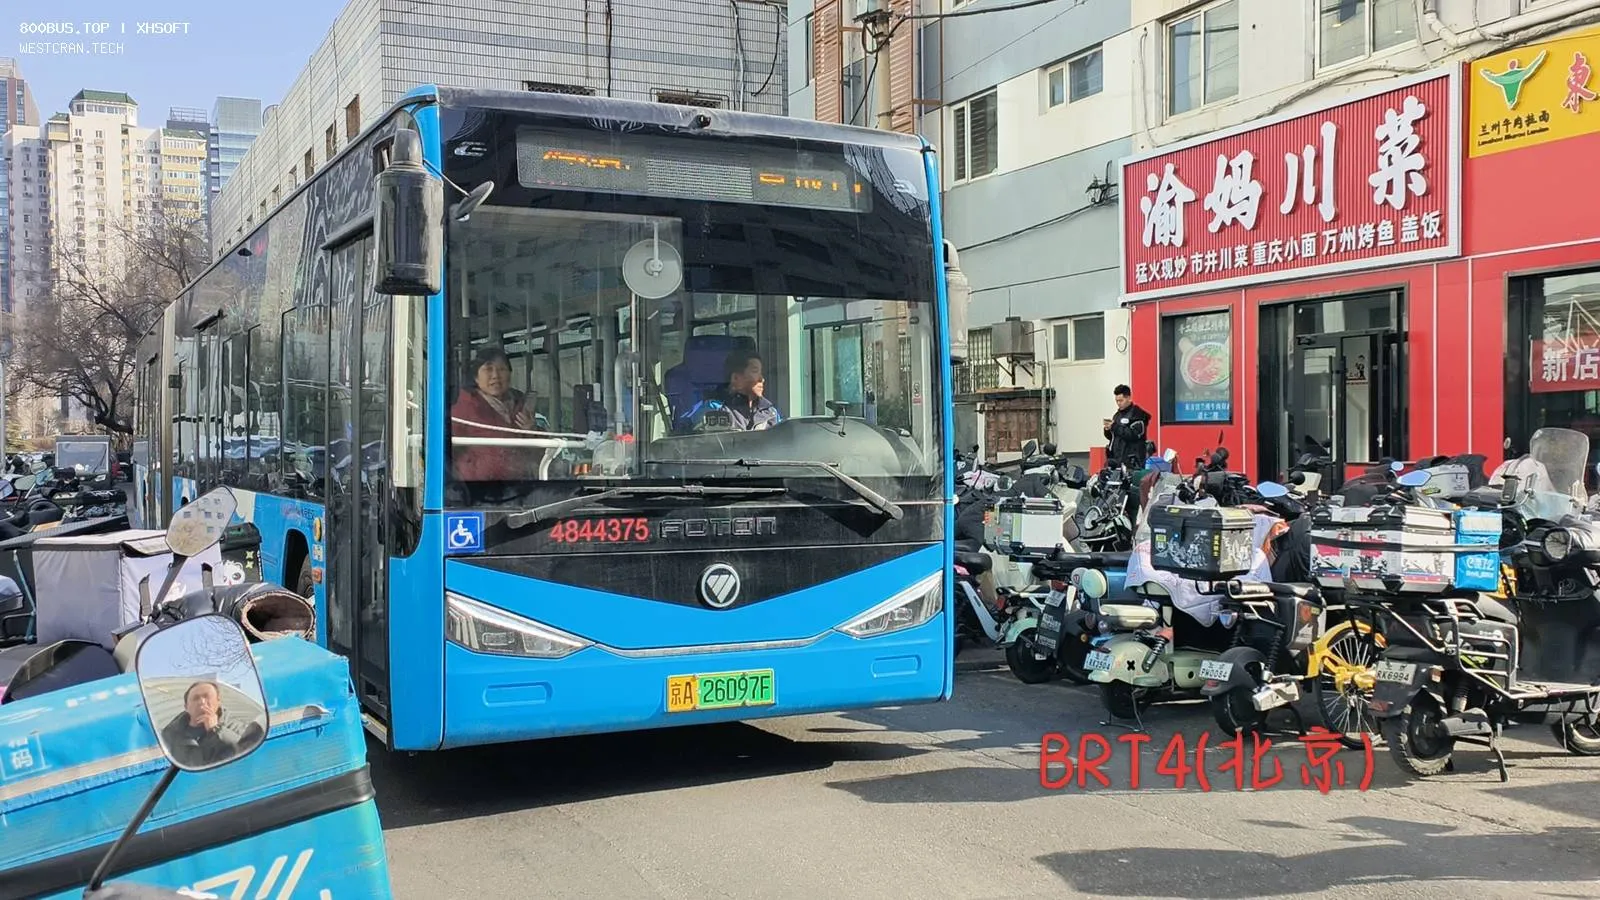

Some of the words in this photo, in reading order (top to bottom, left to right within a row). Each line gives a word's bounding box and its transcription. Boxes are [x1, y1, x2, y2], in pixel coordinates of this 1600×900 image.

[1478, 110, 1550, 136] 兰州牛肉拉面
[1140, 95, 1428, 248] 渝妈川菜
[1135, 254, 1187, 285] 猛火现炒
[1190, 243, 1249, 275] 市井川菜
[1252, 231, 1317, 267] 重庆小面
[1321, 219, 1396, 256] 万州烤鱼
[1401, 210, 1442, 243] 盖饭
[1542, 347, 1599, 382] 新店
[550, 518, 649, 543] 4844375
[660, 517, 776, 538] FOTON
[1377, 670, 1411, 681] RK6994
